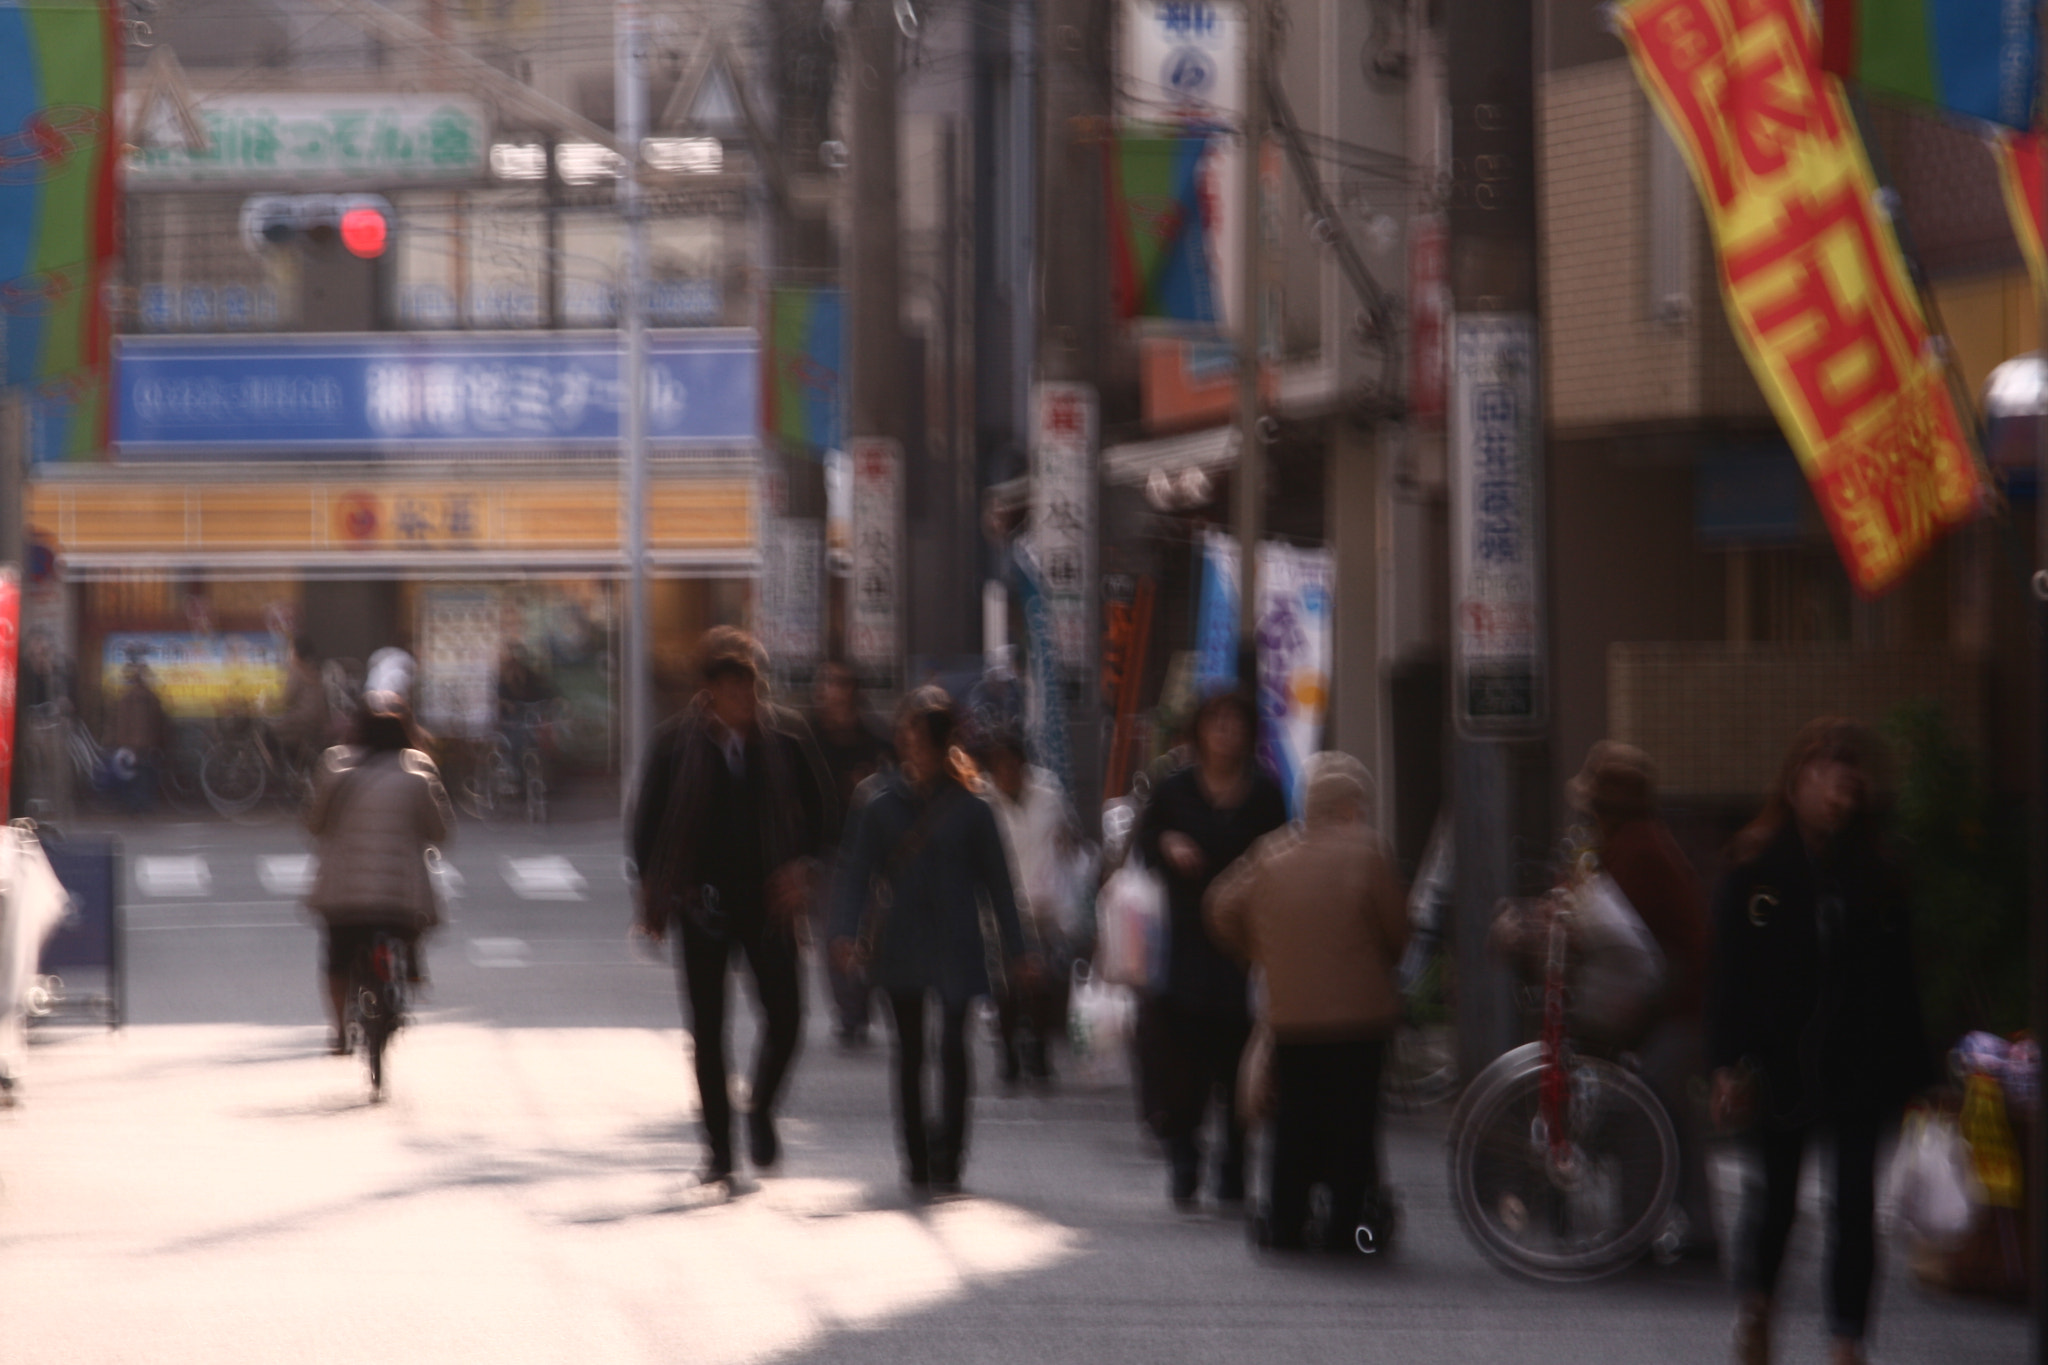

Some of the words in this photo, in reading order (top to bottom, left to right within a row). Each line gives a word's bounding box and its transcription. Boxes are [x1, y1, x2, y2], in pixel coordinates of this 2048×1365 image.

[371, 370, 682, 422] 湘南ゼミナール
[1046, 398, 1083, 439] 質
[1477, 390, 1516, 568] 回生医院
[394, 499, 476, 541] 松屋
